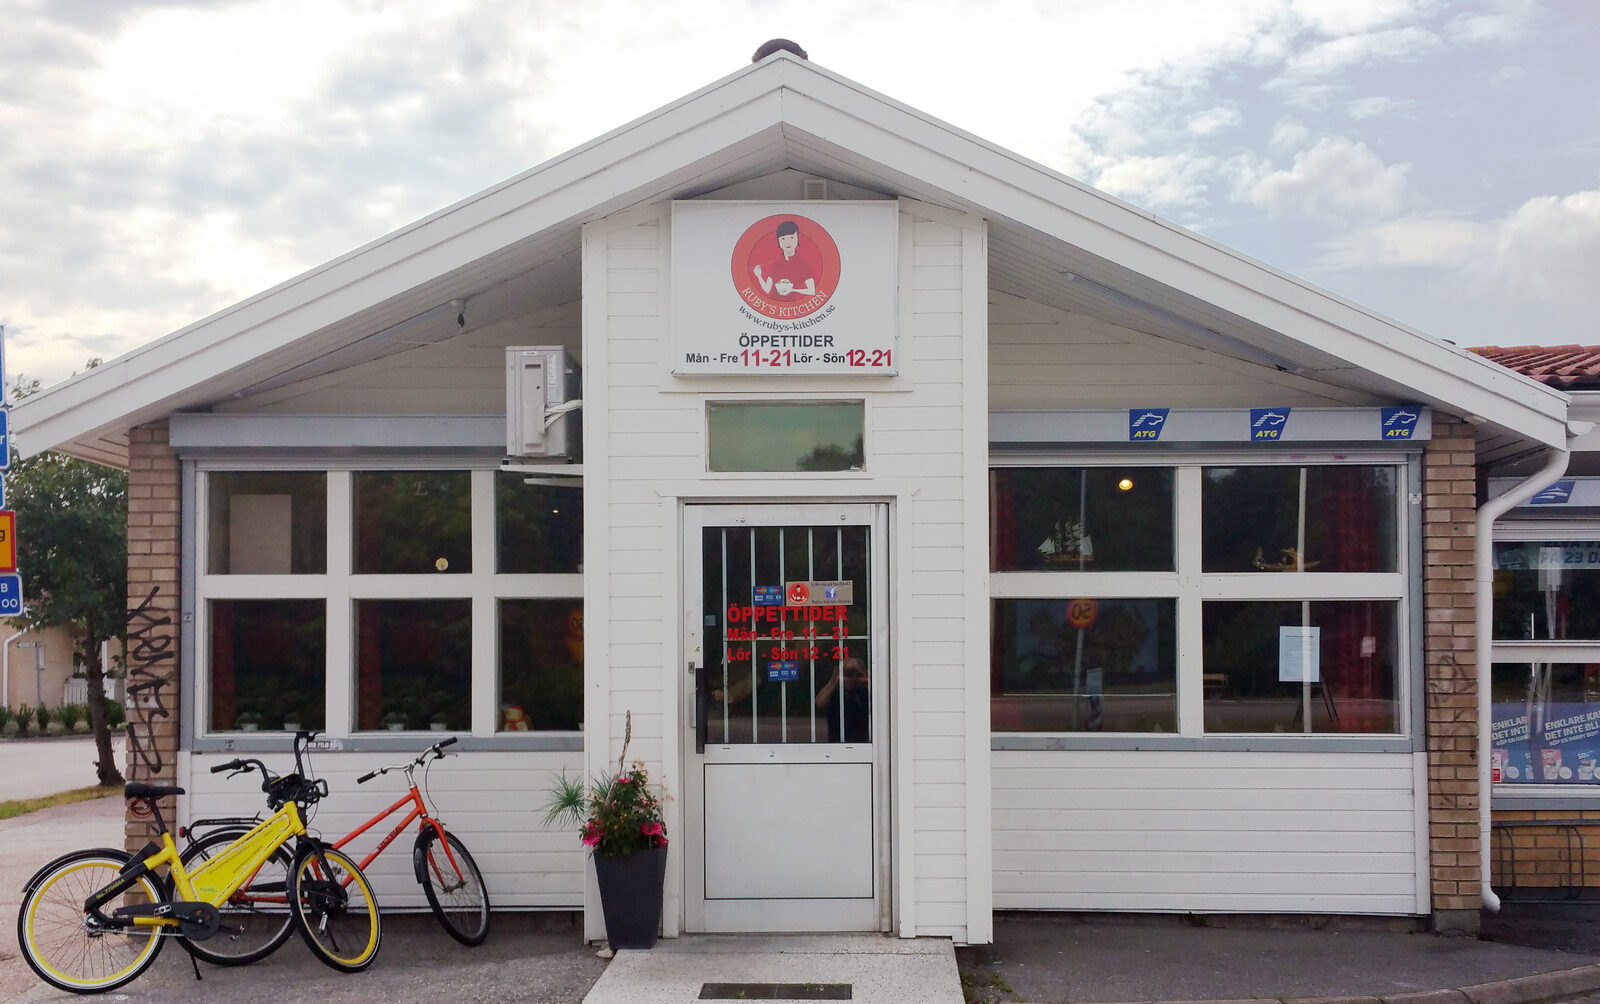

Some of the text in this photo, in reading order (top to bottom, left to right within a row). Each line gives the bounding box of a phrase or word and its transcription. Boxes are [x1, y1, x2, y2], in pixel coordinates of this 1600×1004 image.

[742, 287, 828, 317] RUBY'S KITCHEN
[739, 304, 836, 332] www.rubys-kitchen.se
[739, 333, 834, 347] ÖPPETTIDER
[686, 352, 709, 363] Mån
[720, 353, 738, 363] Fre
[740, 349, 791, 366] 11-21
[793, 352, 812, 363] Lör
[823, 352, 845, 363] Sön
[845, 349, 892, 366] 12-21
[1133, 430, 1156, 438] ATG
[1254, 430, 1278, 438] ATG
[1385, 429, 1409, 437] ATG
[1564, 551, 1584, 564] 23
[727, 604, 847, 622] ÖPPETTIDER
[727, 627, 757, 640] Mån
[771, 627, 794, 640] Fre
[801, 627, 817, 640] 11
[832, 626, 848, 639] 21
[727, 647, 751, 661] Lör
[771, 647, 798, 661] Sön
[801, 647, 819, 660] 12
[832, 647, 849, 660] 21
[1545, 711, 1600, 731] ENKLARE KA
[1492, 730, 1509, 741] DET
[1544, 729, 1562, 741] DET
[1563, 724, 1583, 737] INTE
